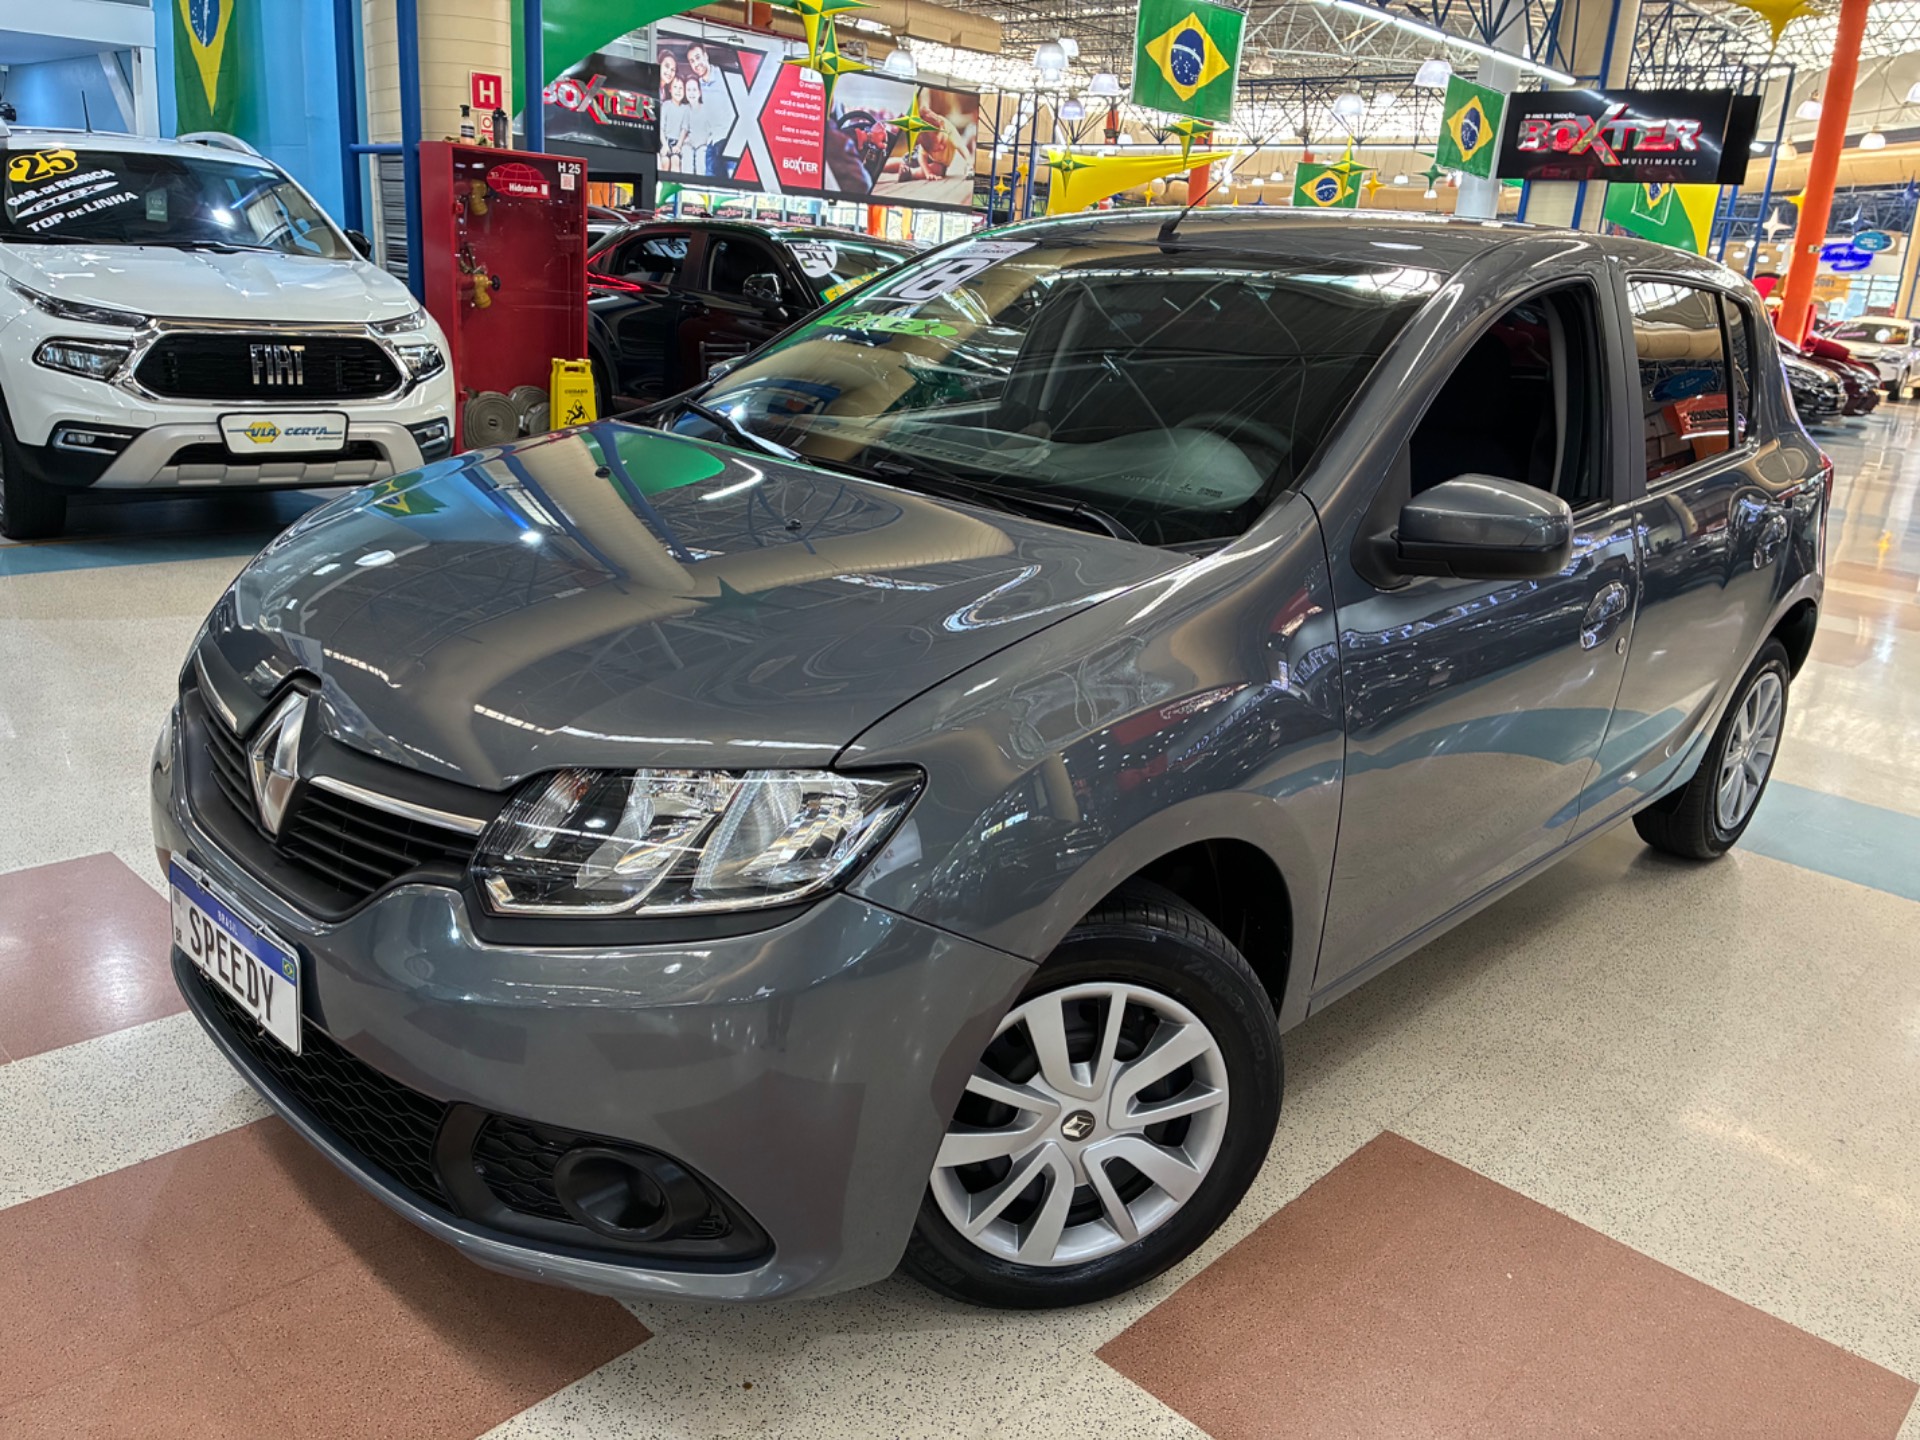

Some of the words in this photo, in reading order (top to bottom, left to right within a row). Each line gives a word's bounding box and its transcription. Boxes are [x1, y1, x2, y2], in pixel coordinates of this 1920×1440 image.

[479, 80, 496, 105] H
[1516, 103, 1703, 166] BOXTER
[9, 149, 78, 182] 25
[557, 162, 566, 173] H
[568, 163, 581, 175] 25
[782, 156, 818, 175] BOXTER
[1622, 157, 1698, 166] MULTIMARCAS
[55, 169, 115, 189] FABRICA
[508, 182, 538, 193] Hidrante
[27, 211, 65, 232] TOP
[67, 207, 86, 219] DE
[85, 191, 139, 212] LINHA
[797, 251, 833, 269] 24
[249, 344, 305, 385] FIAT
[250, 427, 277, 438] VIA
[284, 426, 327, 436] CERTA
[217, 909, 238, 936] BRASIL
[189, 906, 274, 1022] SPEEDY
